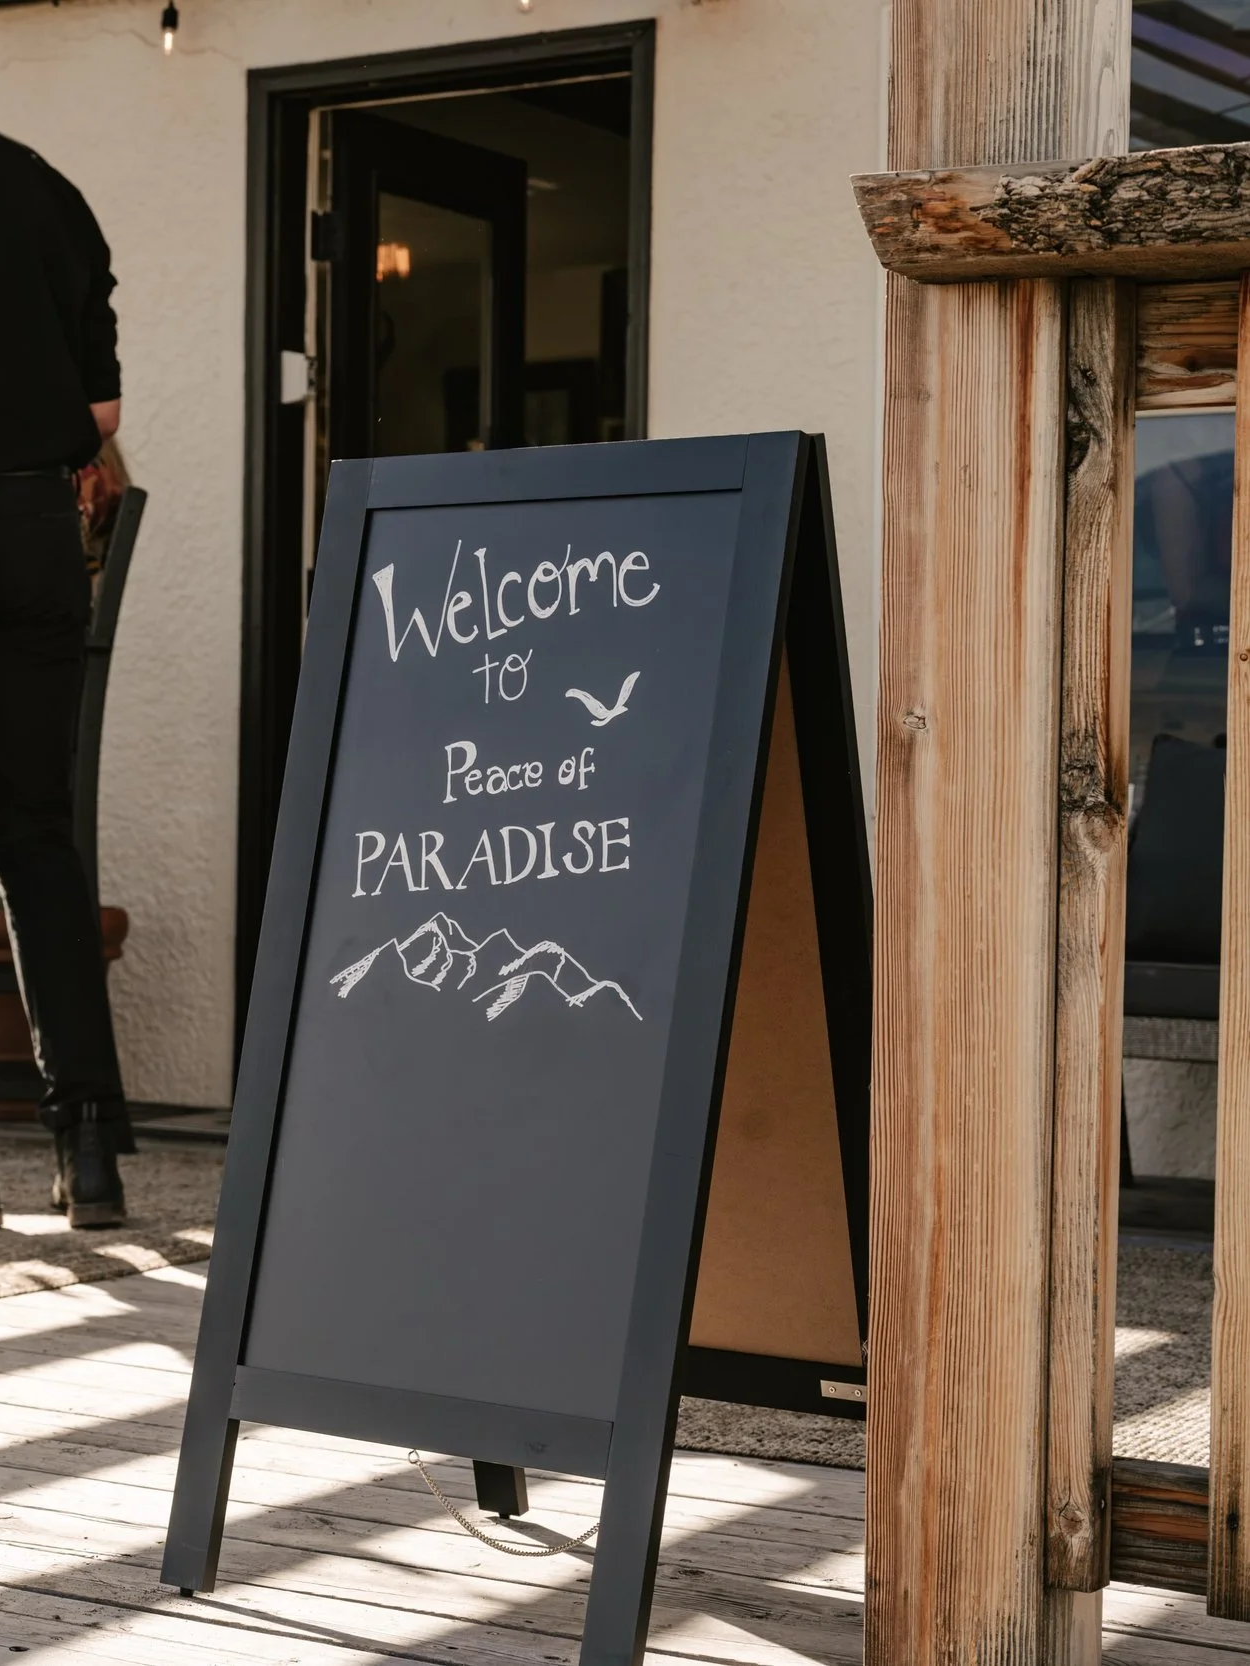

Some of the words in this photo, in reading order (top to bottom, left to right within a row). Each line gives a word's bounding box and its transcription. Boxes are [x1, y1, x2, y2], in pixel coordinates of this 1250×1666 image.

[473, 649, 532, 703] to
[443, 741, 543, 803] Peace
[558, 747, 595, 790] of
[352, 818, 630, 897] PARADISE
